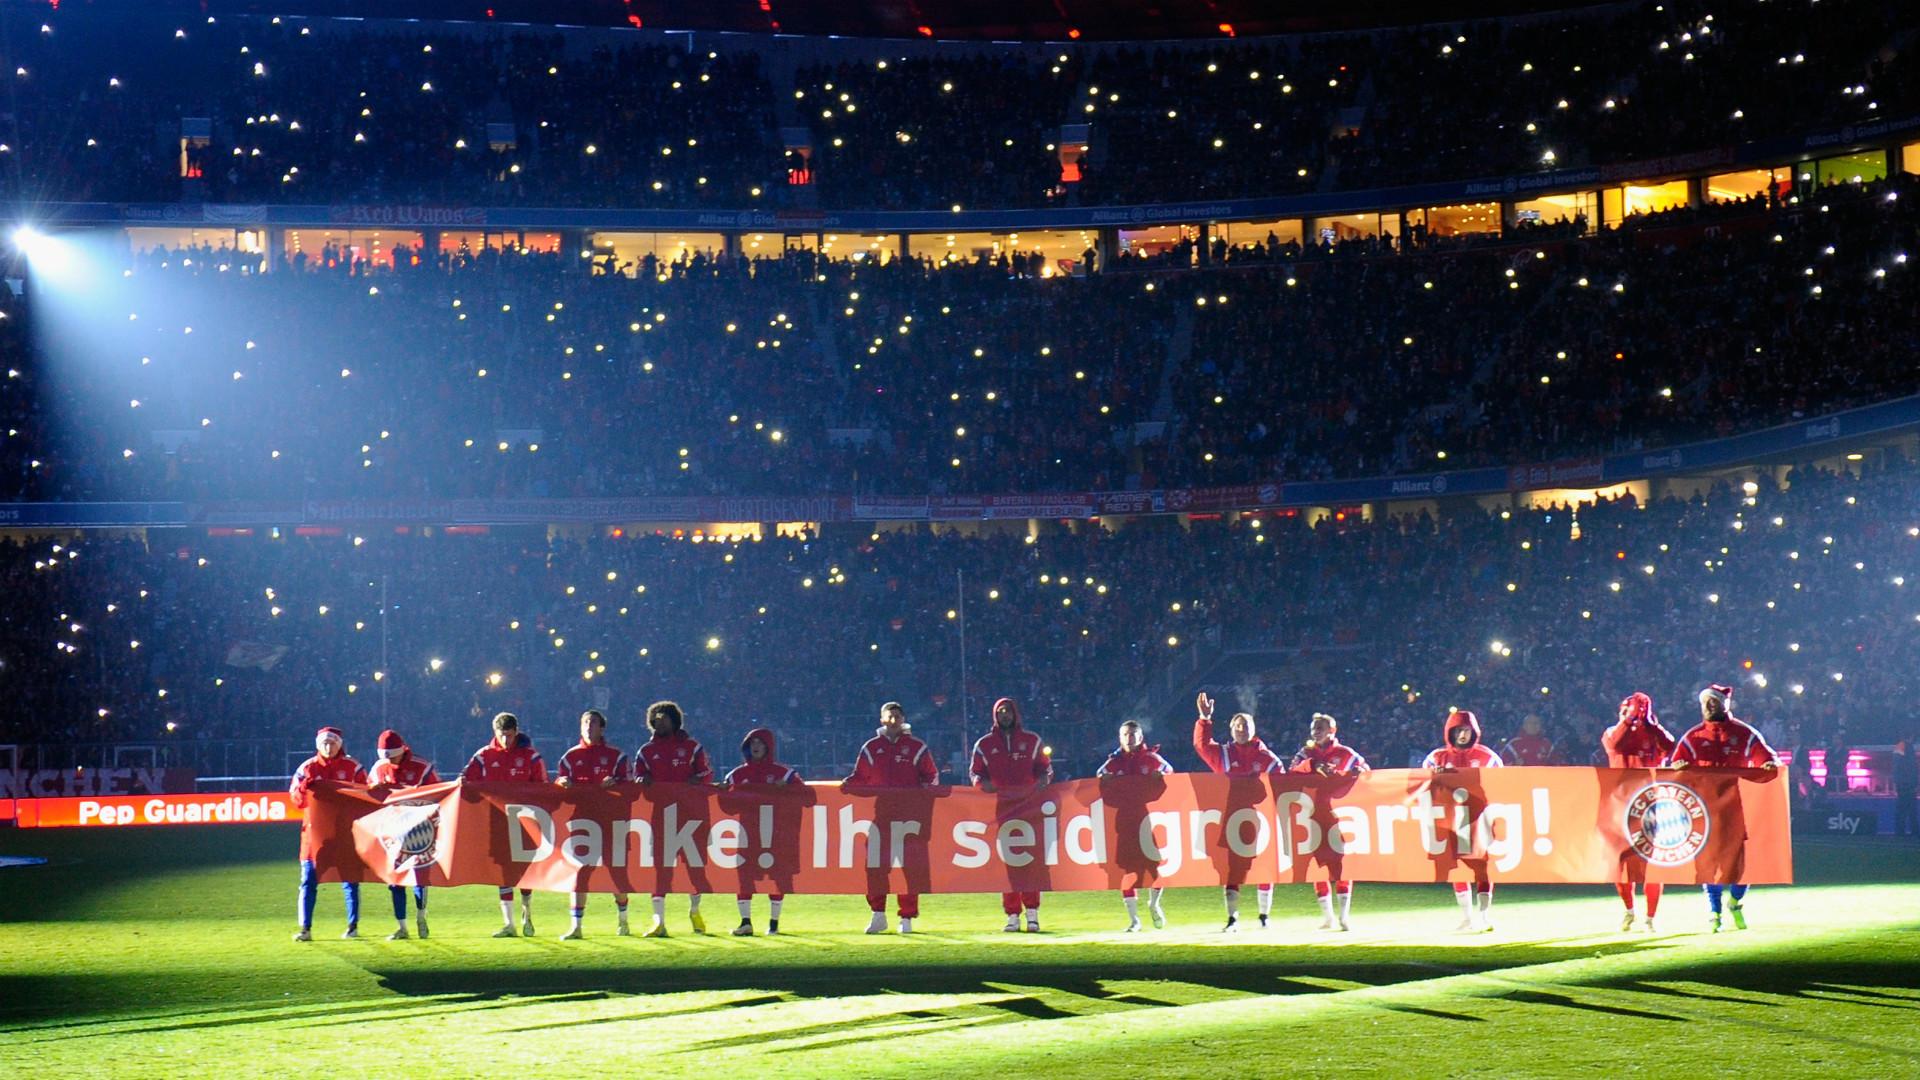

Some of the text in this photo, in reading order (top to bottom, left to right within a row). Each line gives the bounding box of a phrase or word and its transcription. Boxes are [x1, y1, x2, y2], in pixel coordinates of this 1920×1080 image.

[1465, 172, 1600, 194] Allianz Global Investor
[698, 214, 735, 225] Allianz
[1091, 205, 1232, 222] Allianz Global Investors
[1391, 480, 1431, 494] Allianz
[79, 796, 286, 825] Pep Guardiola
[1630, 786, 1704, 820] FC BAYERN
[503, 787, 1554, 877] Danke! Ihr seid großartig!
[1827, 812, 1860, 834] sky
